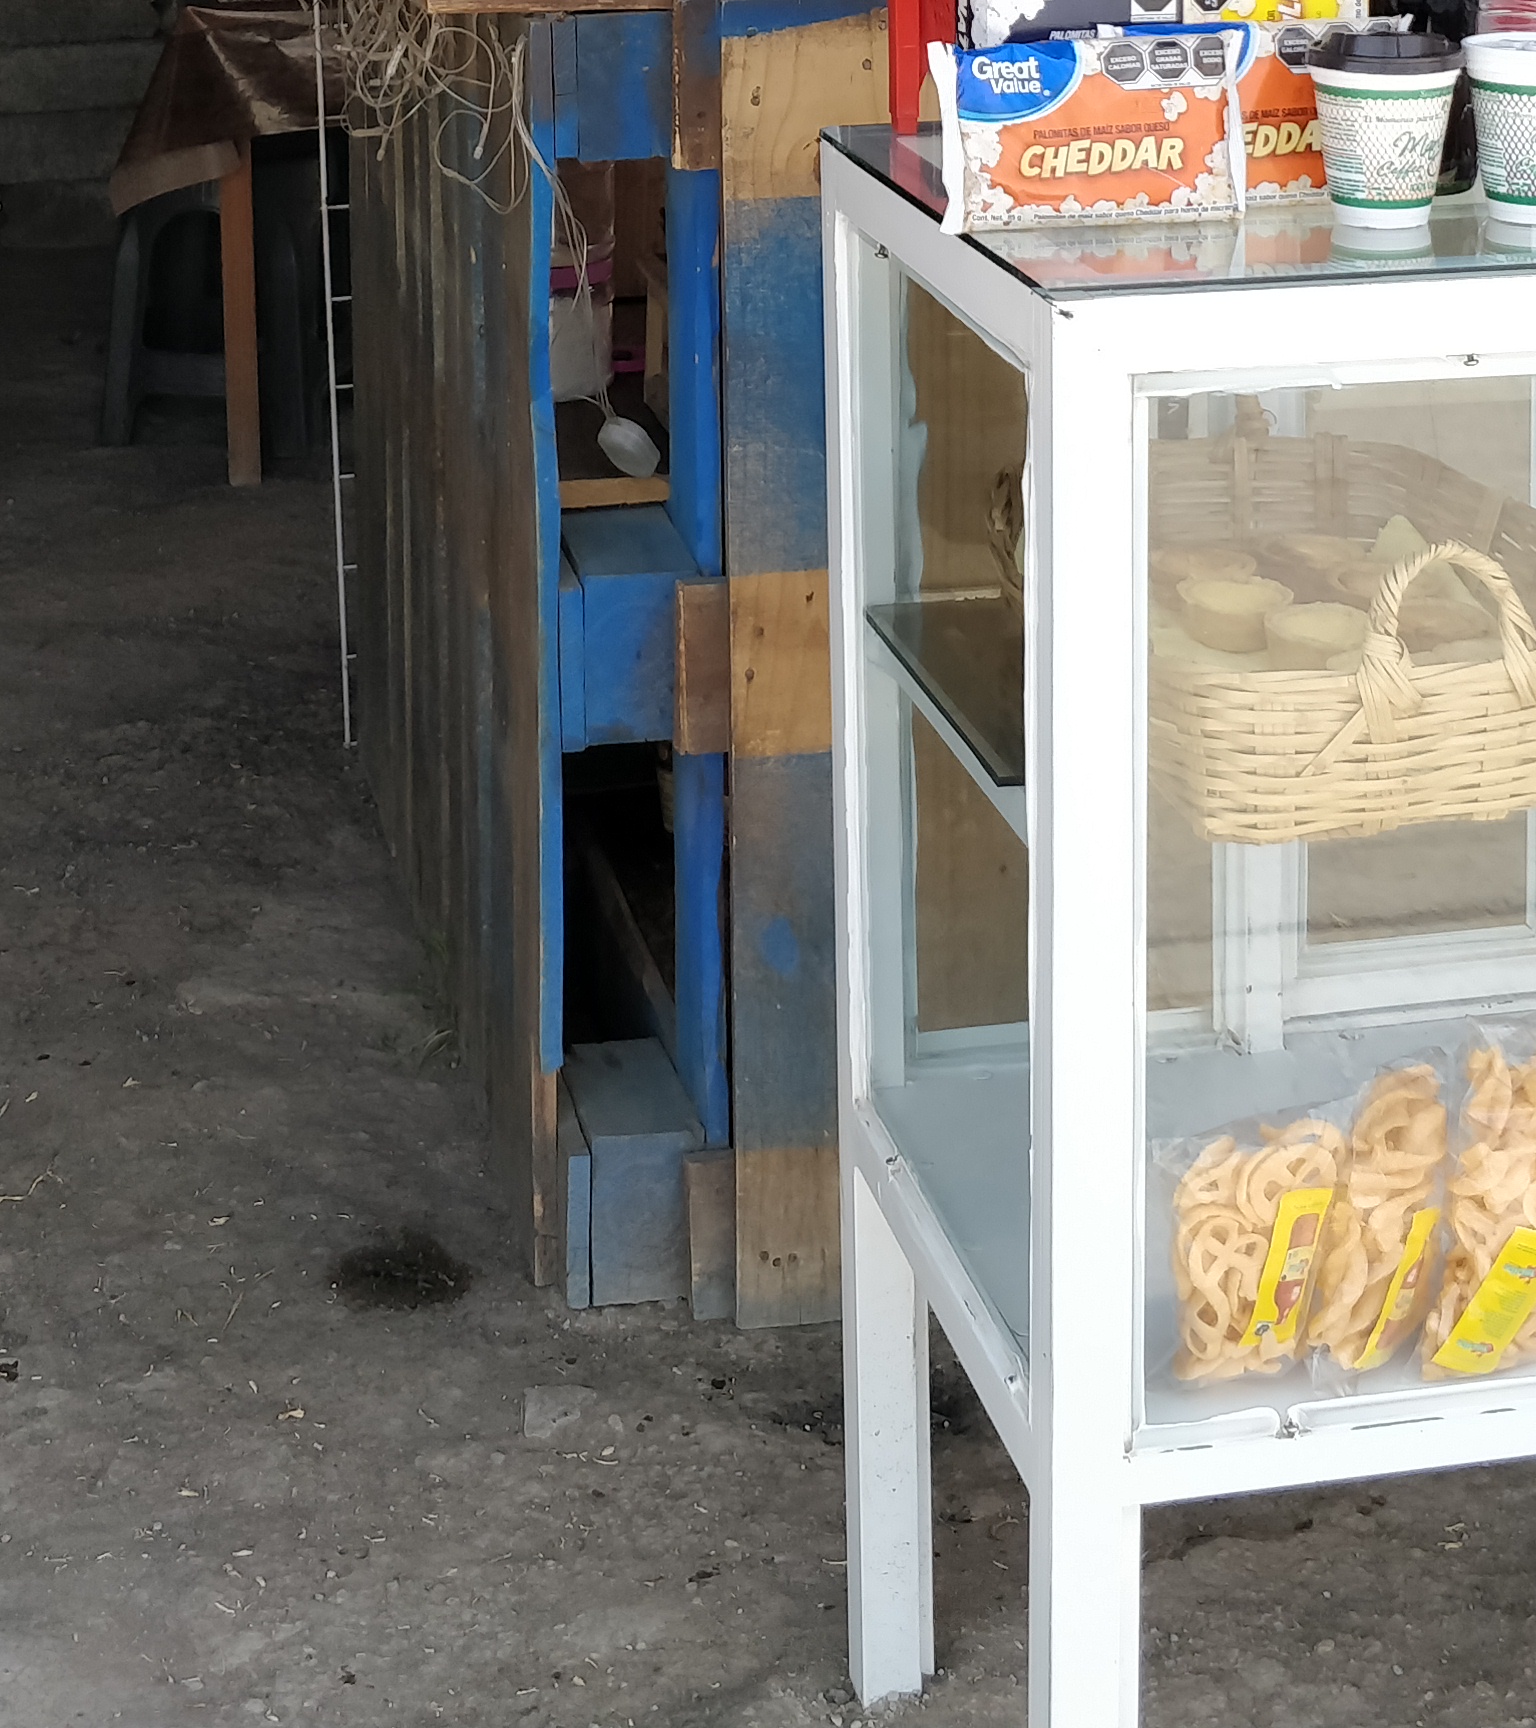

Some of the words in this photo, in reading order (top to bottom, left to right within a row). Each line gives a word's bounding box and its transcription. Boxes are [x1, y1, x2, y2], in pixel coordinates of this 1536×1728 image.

[1049, 28, 1096, 41] PALOMITAS
[971, 56, 1040, 80] Great
[990, 77, 1041, 95] Value
[1032, 126, 1080, 140] PALOMITAS
[1079, 125, 1092, 138] DE
[1093, 122, 1114, 136] MAÍZ
[1114, 122, 1143, 135] SABOR
[1143, 120, 1171, 133] QUESO
[1241, 118, 1322, 159] EDDA
[1019, 134, 1185, 180] CHEDDAR
